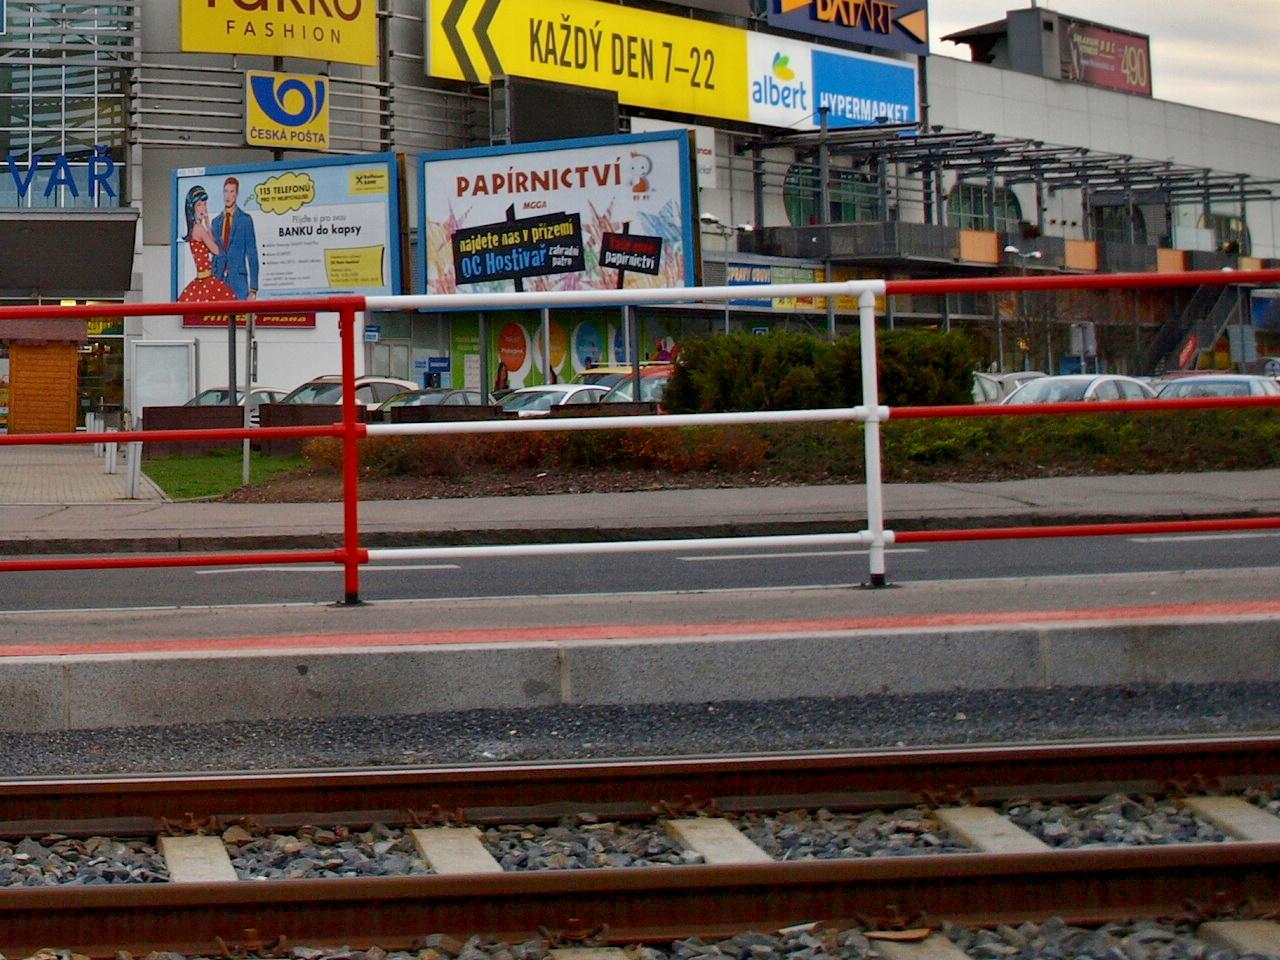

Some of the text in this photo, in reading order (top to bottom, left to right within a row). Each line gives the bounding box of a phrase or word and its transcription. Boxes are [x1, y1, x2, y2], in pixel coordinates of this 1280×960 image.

[226, 20, 342, 44] FASHION
[529, 13, 602, 74] KAŽDÝ
[612, 32, 655, 81] DEN
[752, 76, 808, 112] albert
[820, 92, 909, 123] HYPERMARKET
[250, 125, 326, 144] ČESKÁ POŠTA
[457, 157, 621, 197] PAPÍRNICTVÍ
[279, 223, 362, 237] BANKU do kapsy
[459, 218, 574, 254] najdete nás v přízemí
[462, 244, 548, 279] OC Hostivař
[605, 251, 655, 270] papírnictví
